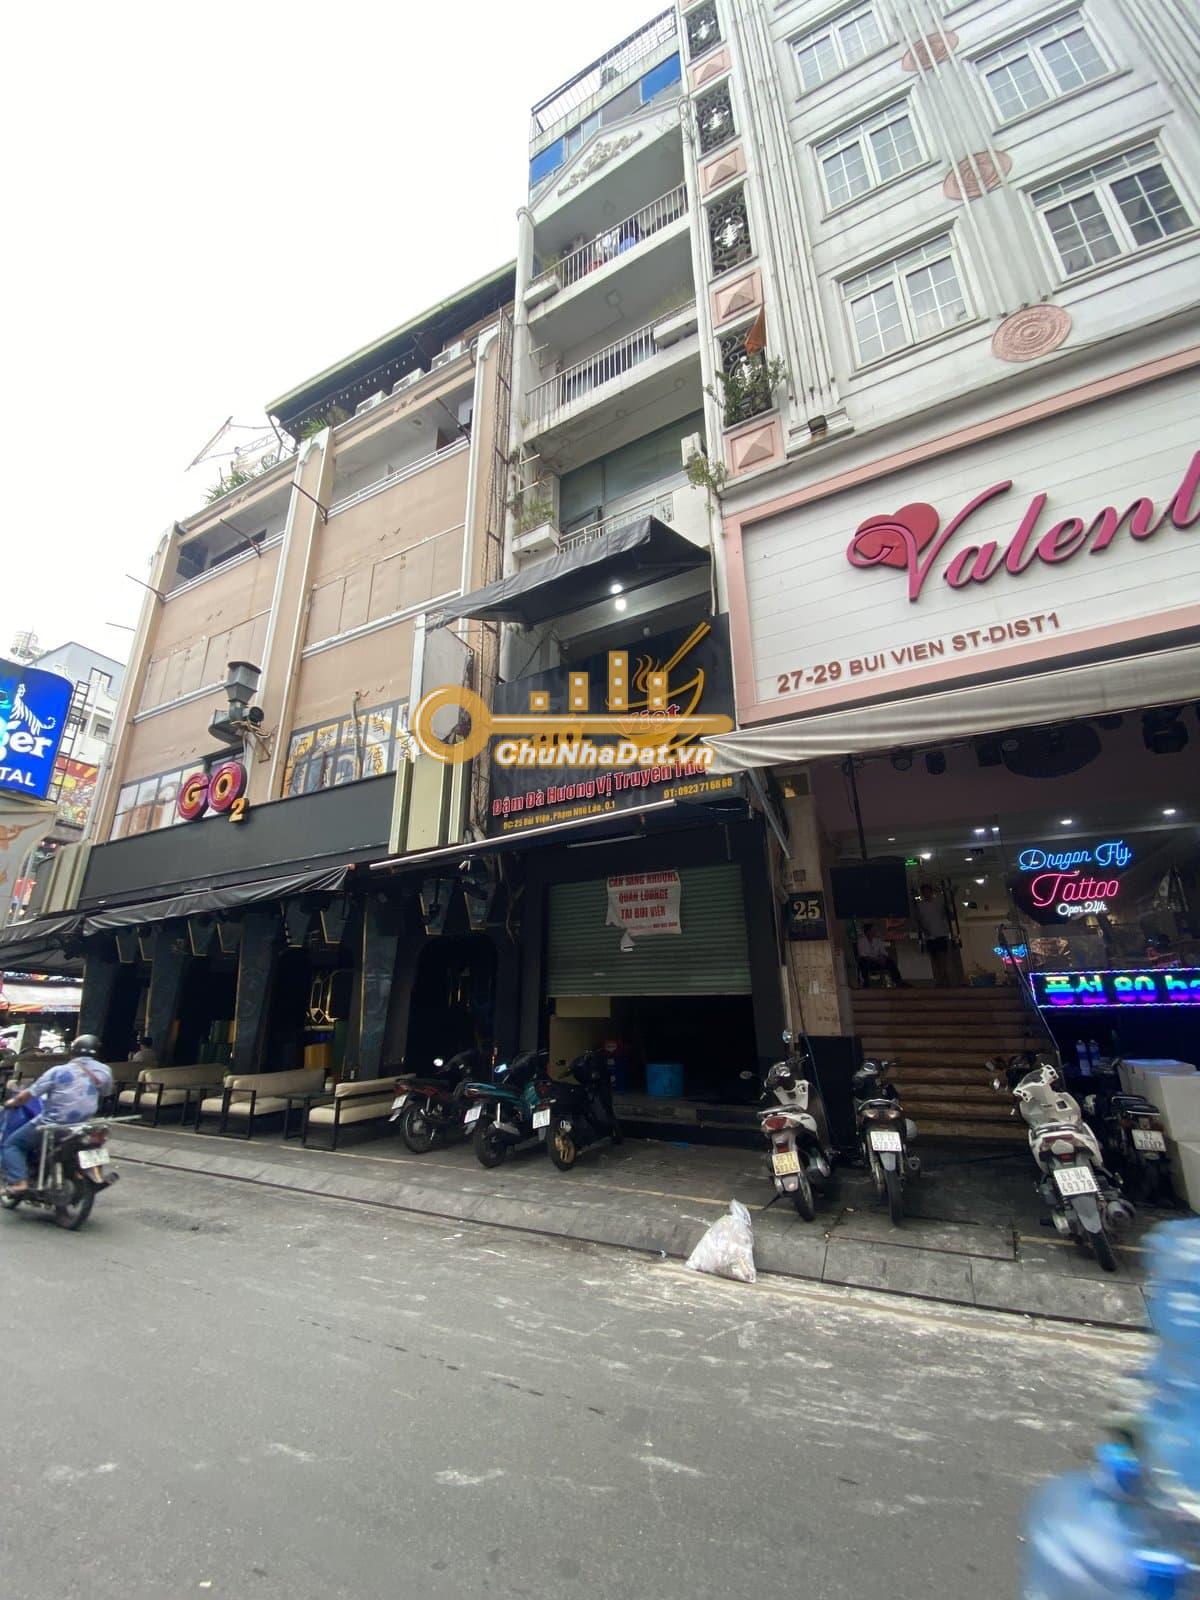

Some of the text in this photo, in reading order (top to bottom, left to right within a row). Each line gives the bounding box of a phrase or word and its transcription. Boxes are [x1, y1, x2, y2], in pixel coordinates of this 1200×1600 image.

[777, 612, 1060, 694] 27-29 BUI VIEN ST-DIST1
[526, 789, 545, 809] Đà
[547, 782, 585, 805] Hương
[596, 773, 612, 797] Vị
[1019, 840, 1132, 870] Dragon Fly
[1031, 870, 1119, 907] Tattoo
[793, 900, 821, 920] 25
[1057, 902, 1084, 916] Open
[1044, 975, 1107, 1005] 풍선
